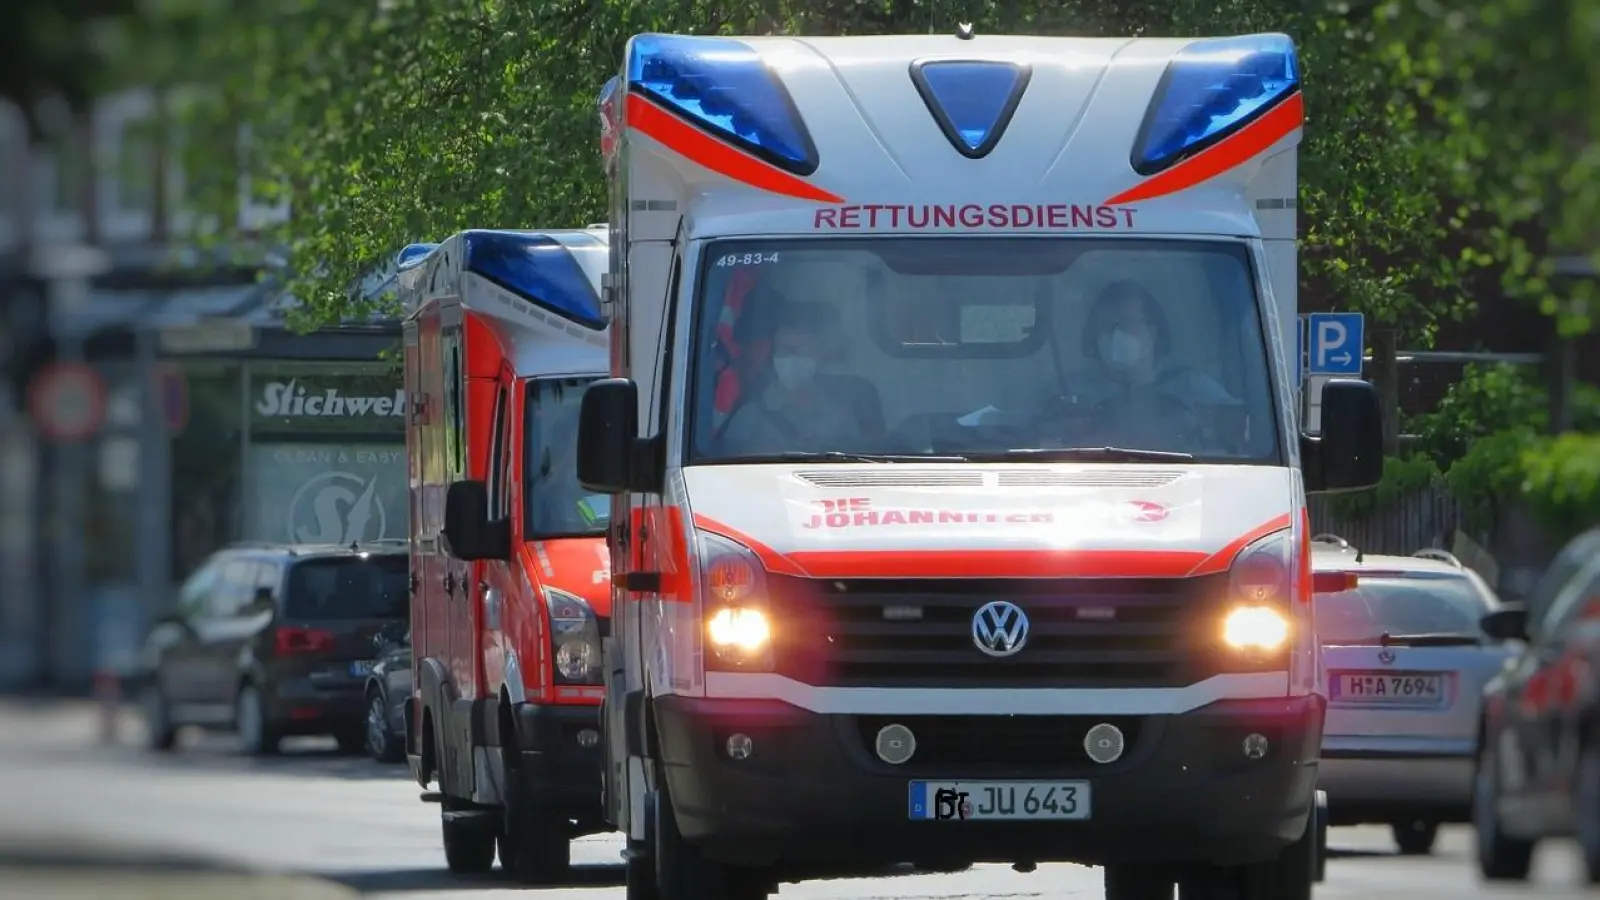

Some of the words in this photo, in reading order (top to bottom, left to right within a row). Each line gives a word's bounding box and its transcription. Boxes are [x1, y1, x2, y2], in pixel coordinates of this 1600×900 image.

[814, 204, 1138, 230] RETTUNGSDIENST
[717, 251, 780, 267] 49-83-4
[1318, 321, 1347, 368] P
[272, 451, 330, 464] CLEAN
[337, 451, 348, 463] &
[356, 452, 400, 464] EASY
[973, 602, 1028, 654] VW
[1391, 677, 1437, 695] 7694
[978, 787, 1015, 815] JU
[1024, 787, 1077, 814] 643
